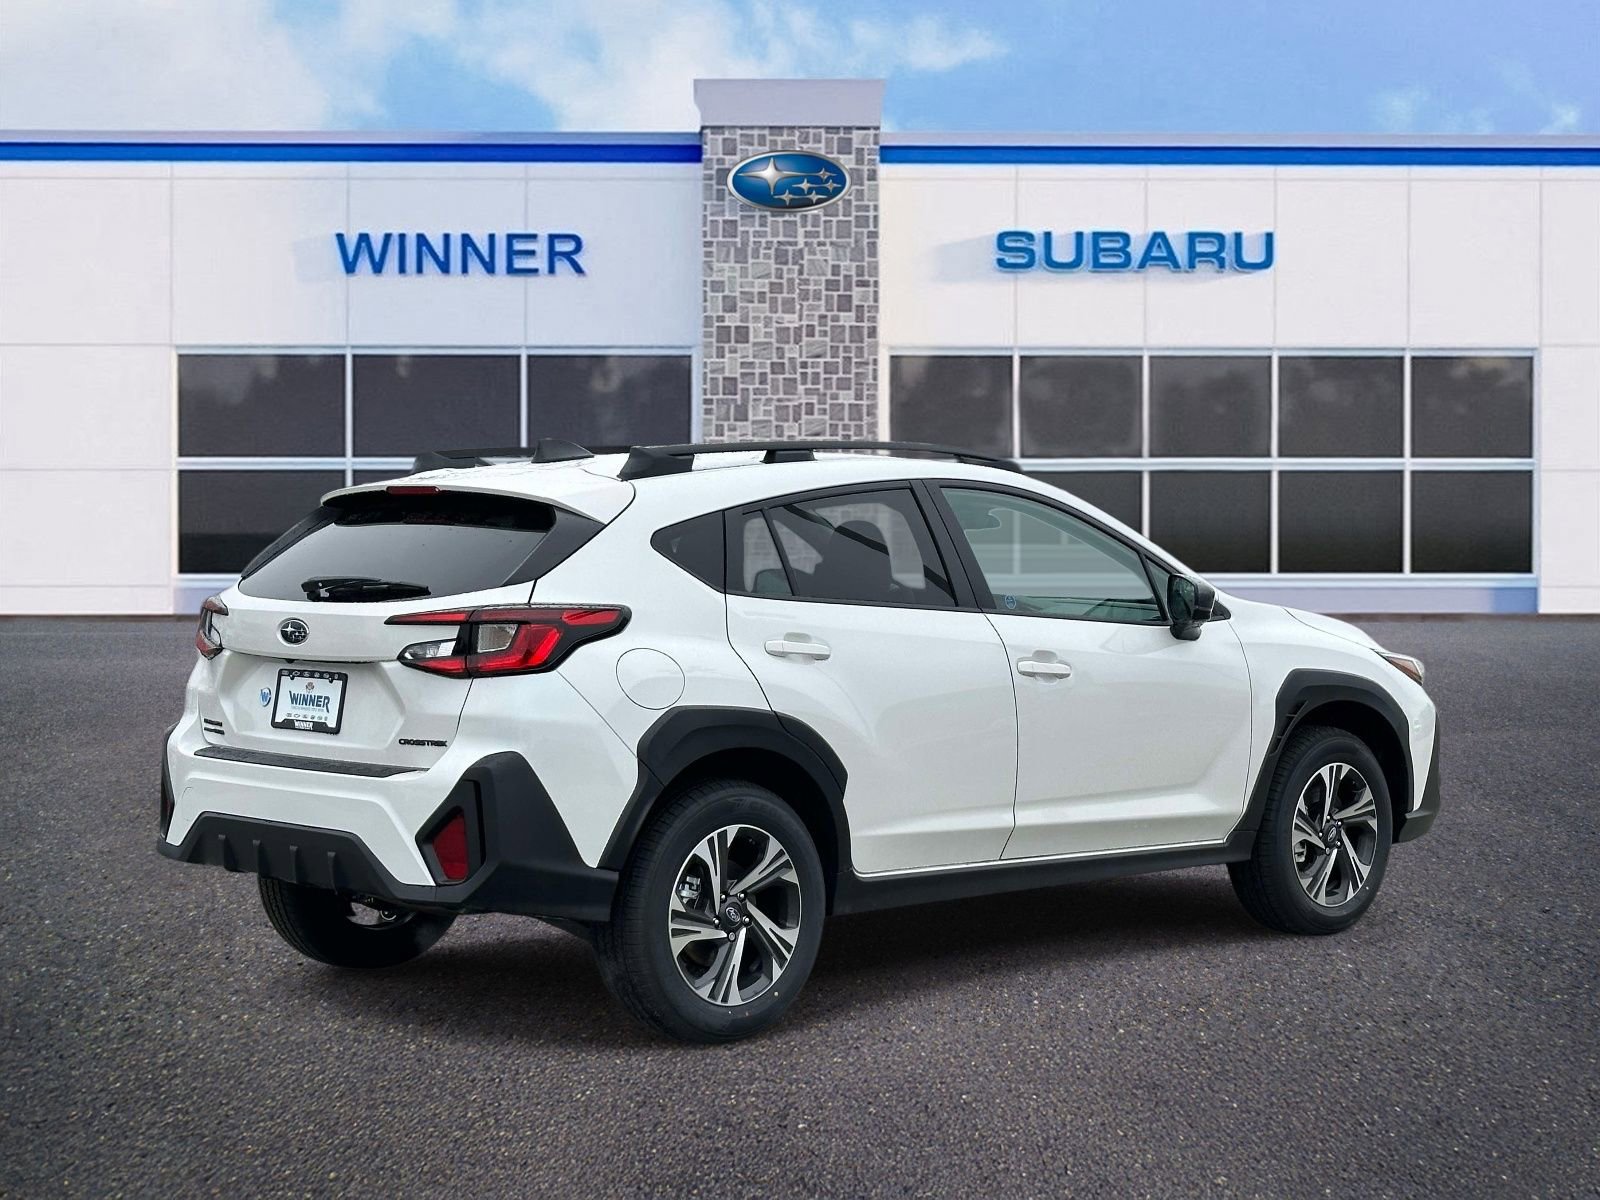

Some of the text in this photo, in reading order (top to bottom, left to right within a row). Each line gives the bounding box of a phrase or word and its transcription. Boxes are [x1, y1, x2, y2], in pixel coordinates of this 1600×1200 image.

[335, 232, 586, 275] WINNER
[996, 231, 1275, 272] SUBARU
[289, 690, 330, 713] WINNER
[399, 738, 448, 748] CROSSTREK
